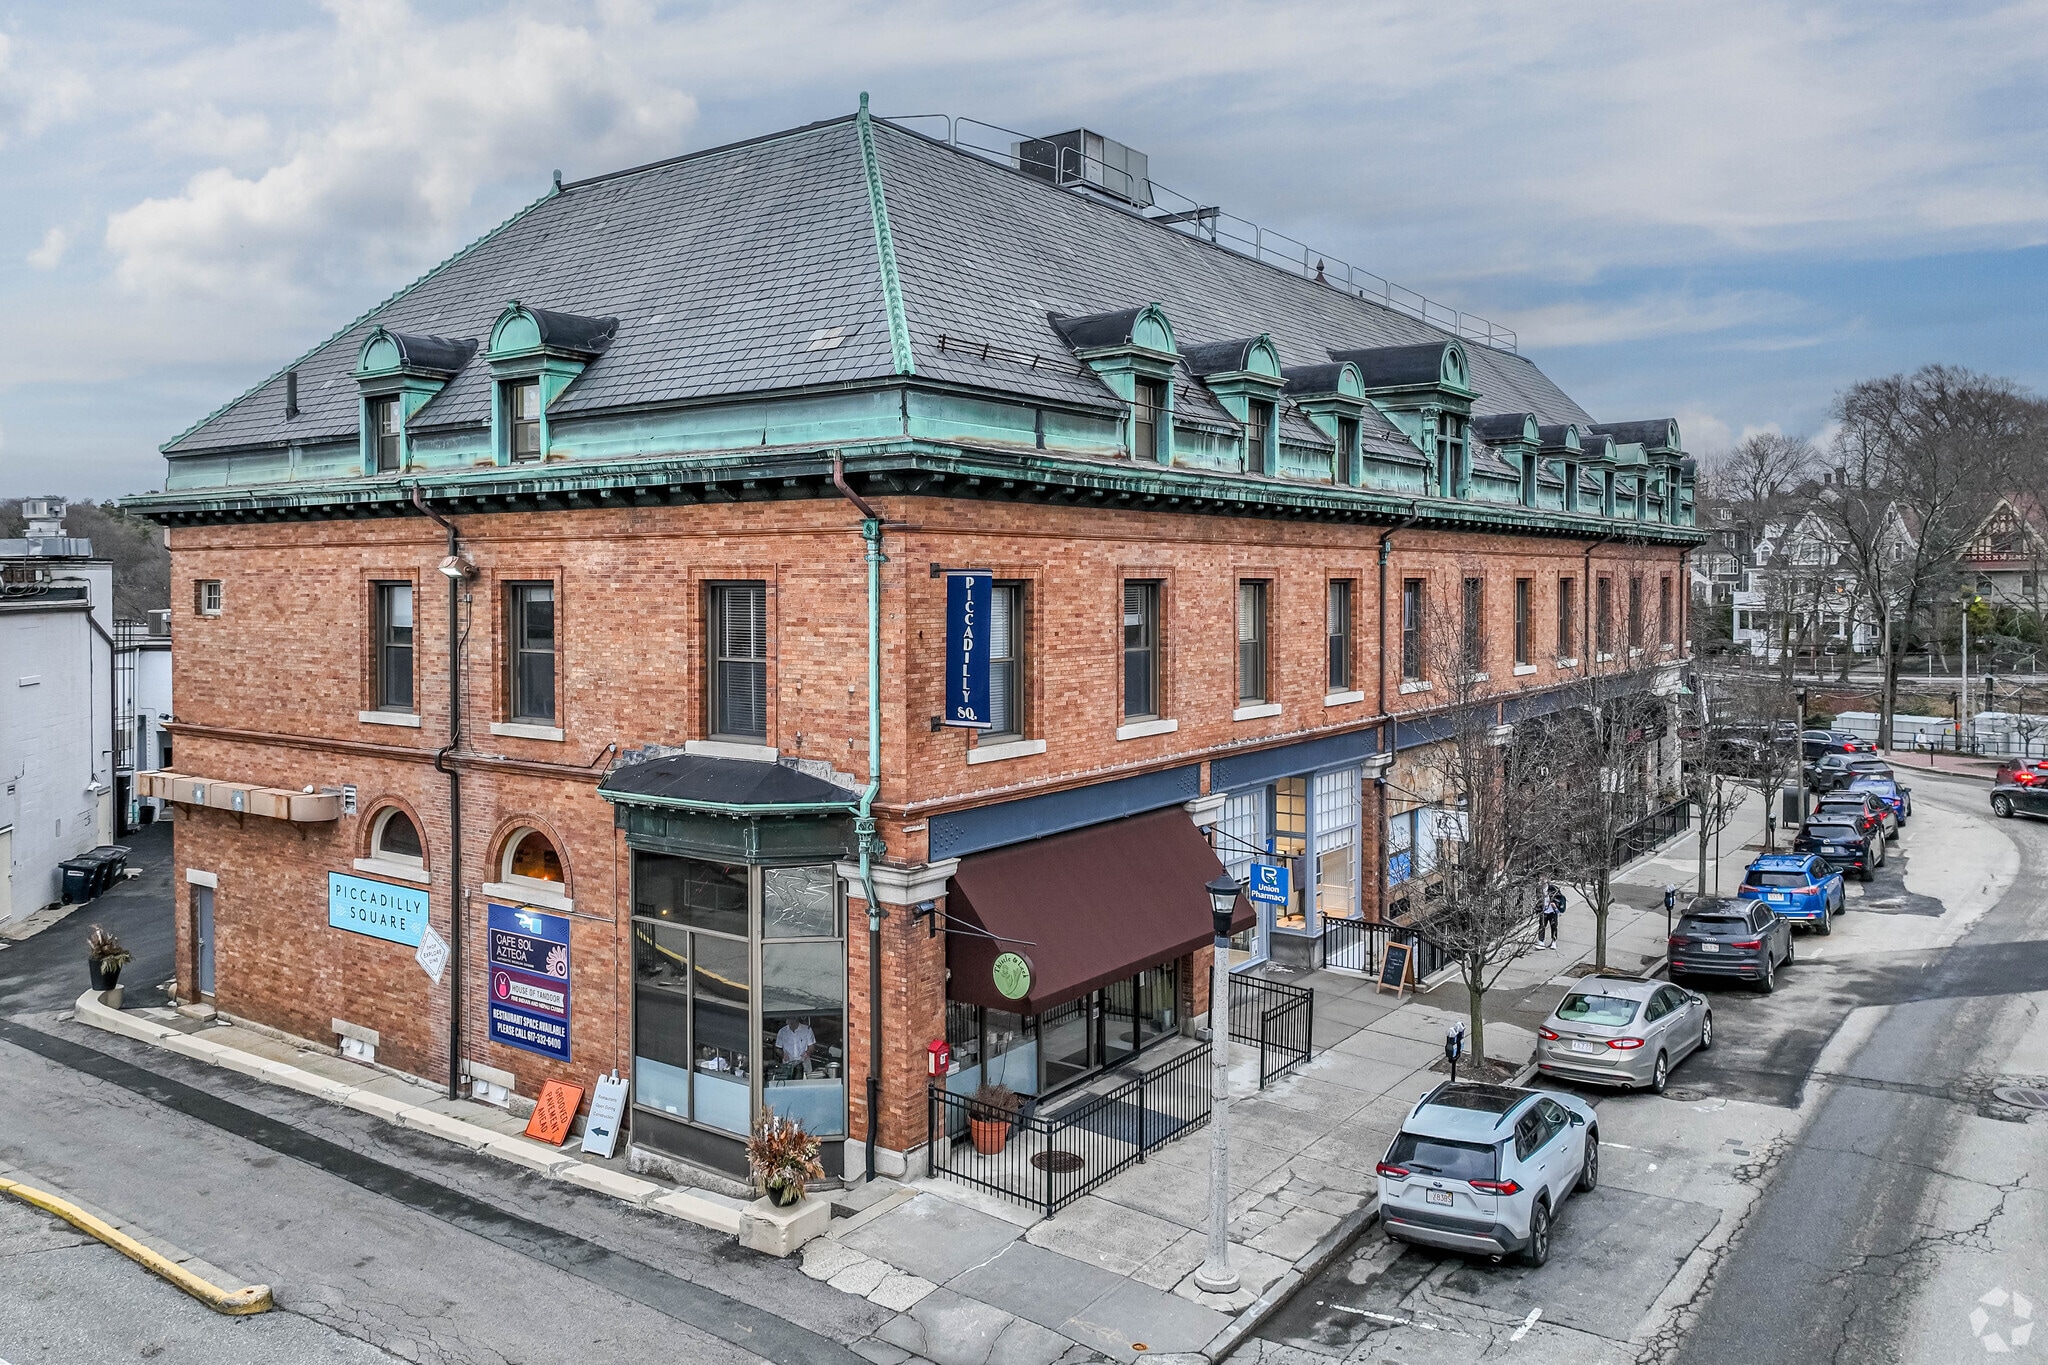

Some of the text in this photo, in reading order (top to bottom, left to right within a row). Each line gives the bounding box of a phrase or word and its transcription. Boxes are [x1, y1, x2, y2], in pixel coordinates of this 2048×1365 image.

[962, 576, 975, 703] PICCADILLY
[957, 706, 977, 721] SQ.
[336, 884, 421, 914] PICCADILLY
[1251, 889, 1286, 904] Pharmacy
[1258, 883, 1279, 893] Union
[350, 906, 406, 931] SQUARE
[423, 949, 442, 958] EXPLORE
[496, 933, 534, 952] CAFE SOL
[496, 946, 528, 962] AZTECA
[994, 954, 1011, 974] Thistle
[1018, 961, 1029, 979] Leek
[511, 984, 561, 1003] HOUSE OF TANDOOR
[492, 1008, 566, 1038] RESTAURANT SPACE AVAILABLE
[497, 1022, 562, 1049] PLEASE CALL 617-332-6400
[545, 1090, 559, 1134] PAVEMENT
[555, 1086, 568, 1124] GROOVED
[537, 1106, 548, 1134] AHEAD
